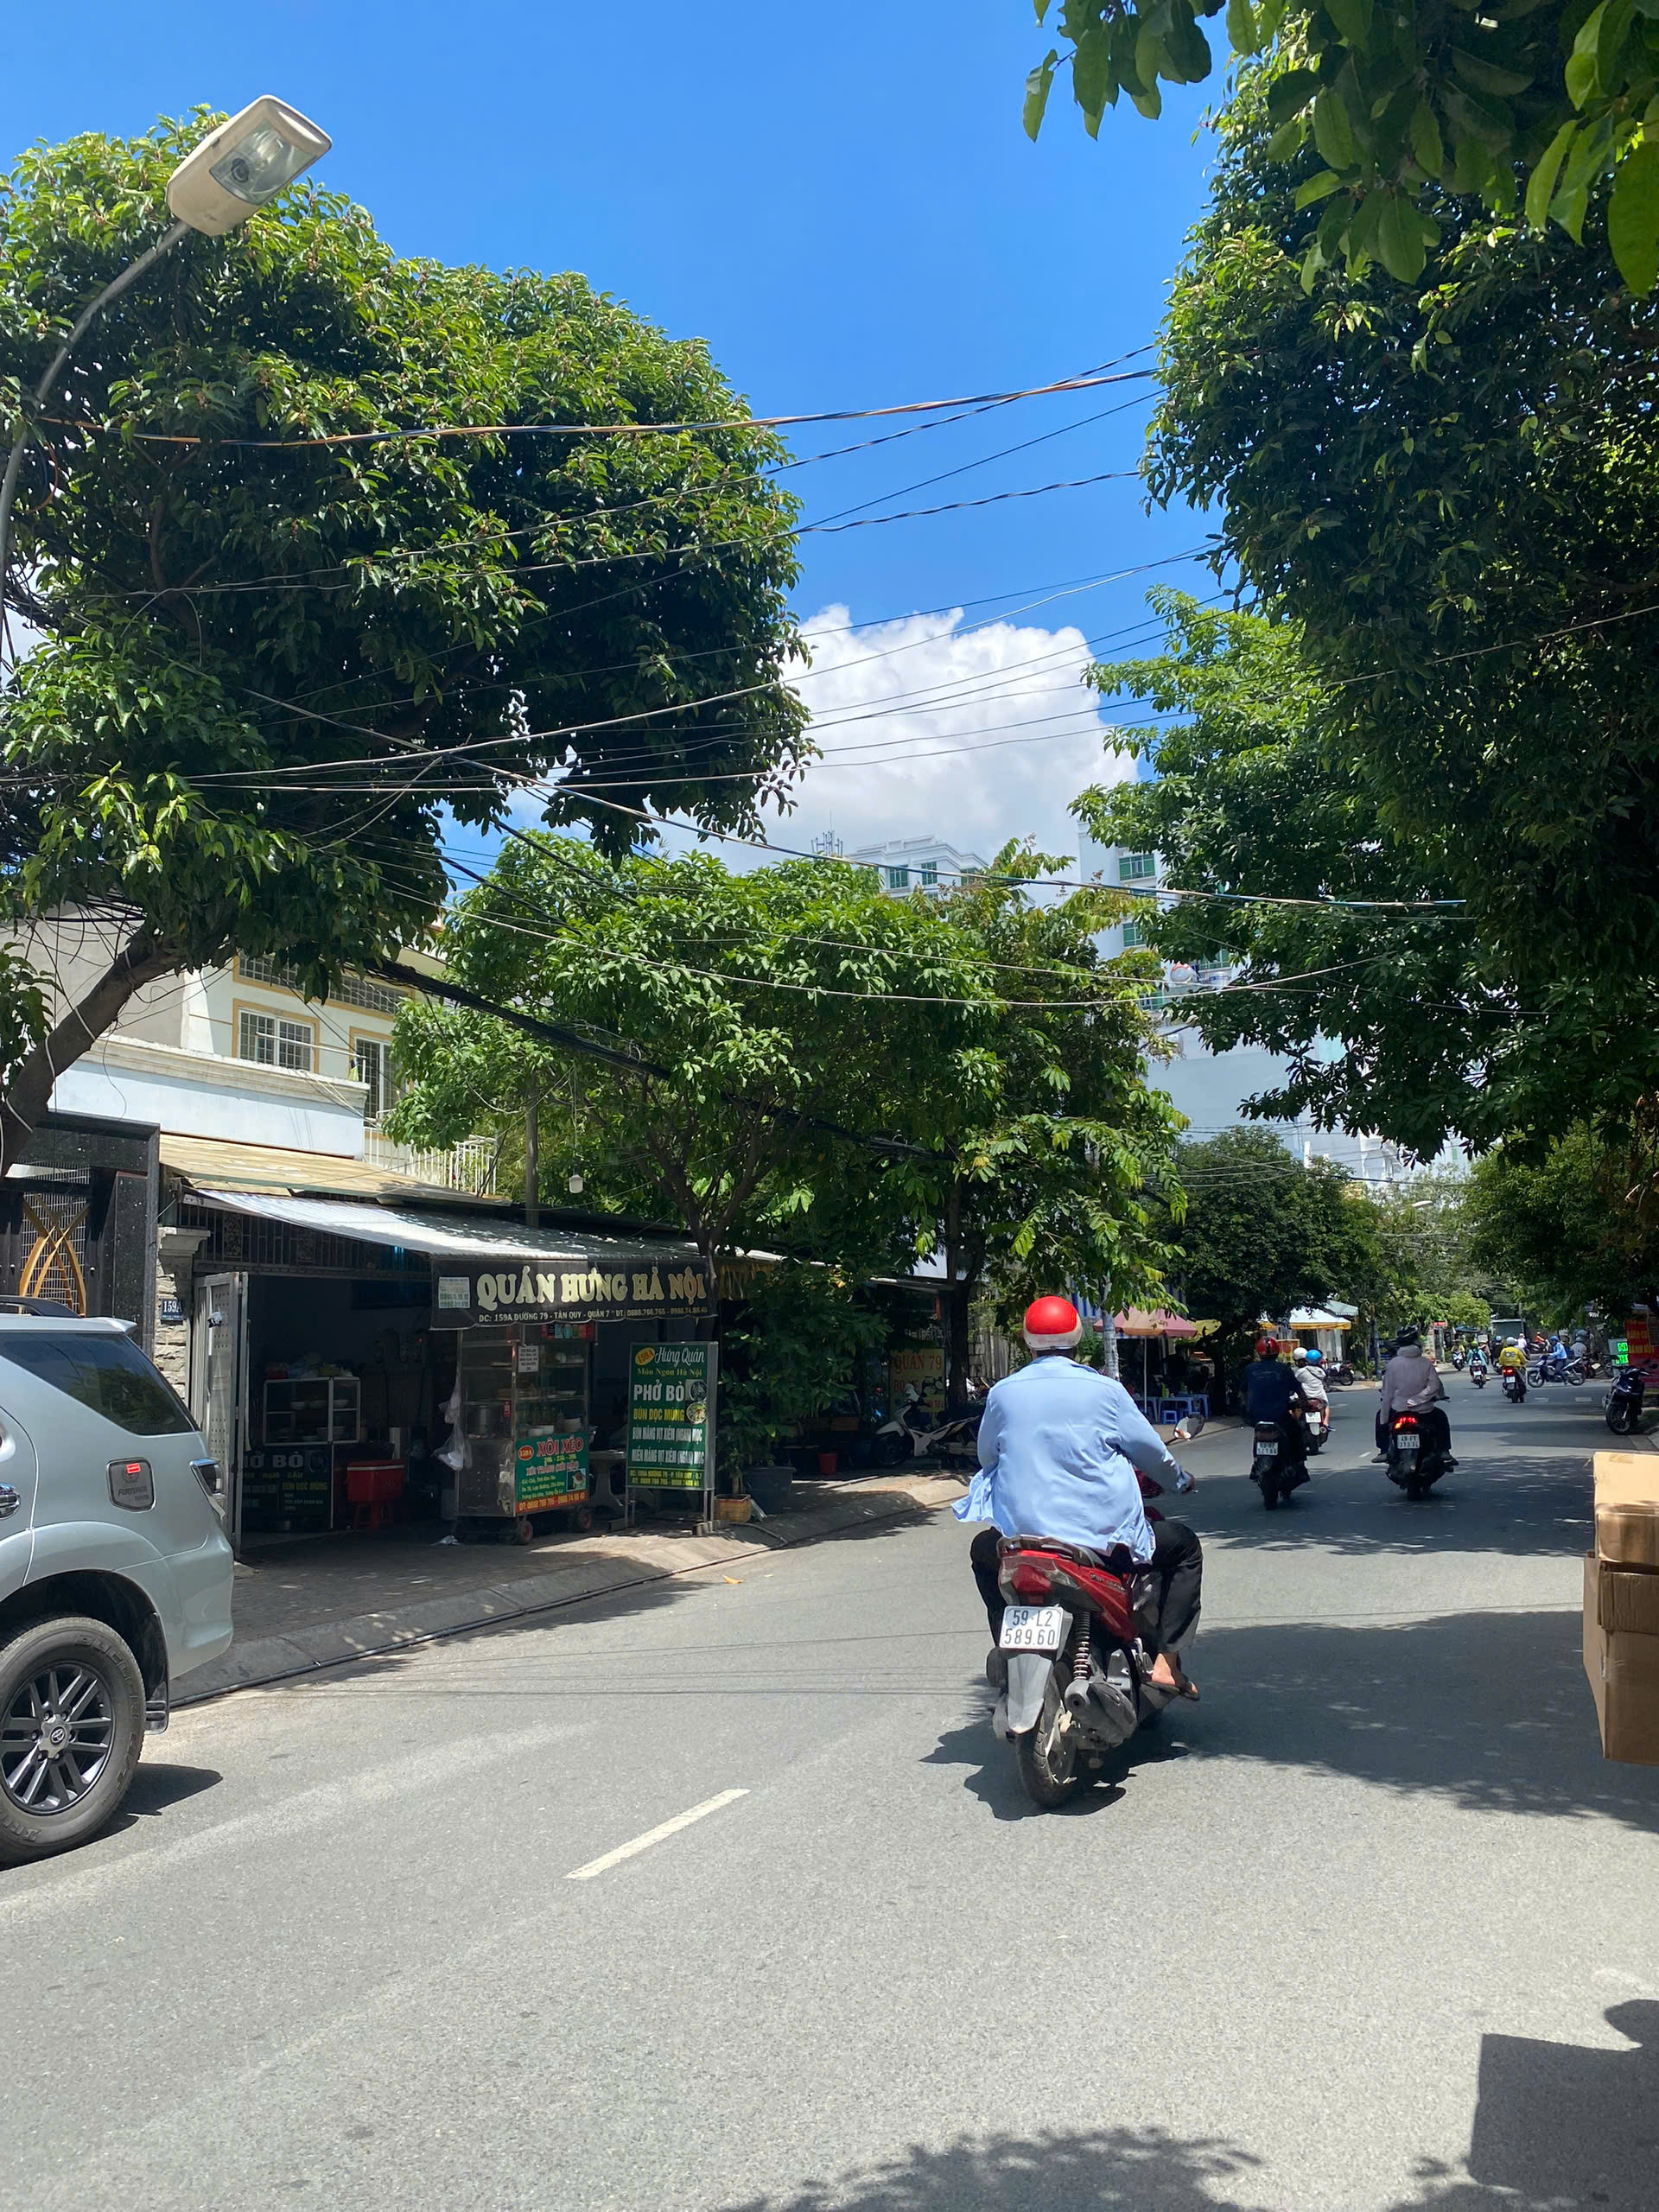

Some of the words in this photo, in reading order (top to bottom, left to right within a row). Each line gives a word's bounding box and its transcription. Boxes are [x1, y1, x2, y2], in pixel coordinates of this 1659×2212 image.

[477, 1265, 556, 1311] QUÁN
[632, 1266, 664, 1300] HÀ
[668, 1266, 707, 1305] NỘI
[163, 1300, 182, 1313] 159A
[494, 1313, 513, 1322] 159A
[539, 1312, 549, 1320] 79
[682, 1347, 705, 1366] Quán
[928, 1355, 942, 1370] 79
[633, 1379, 663, 1402] PHỞ
[665, 1381, 684, 1402] BÒ
[537, 1436, 559, 1457] XÔI
[272, 1451, 303, 1468] BÒ
[1004, 1628, 1056, 1646] 589.60
